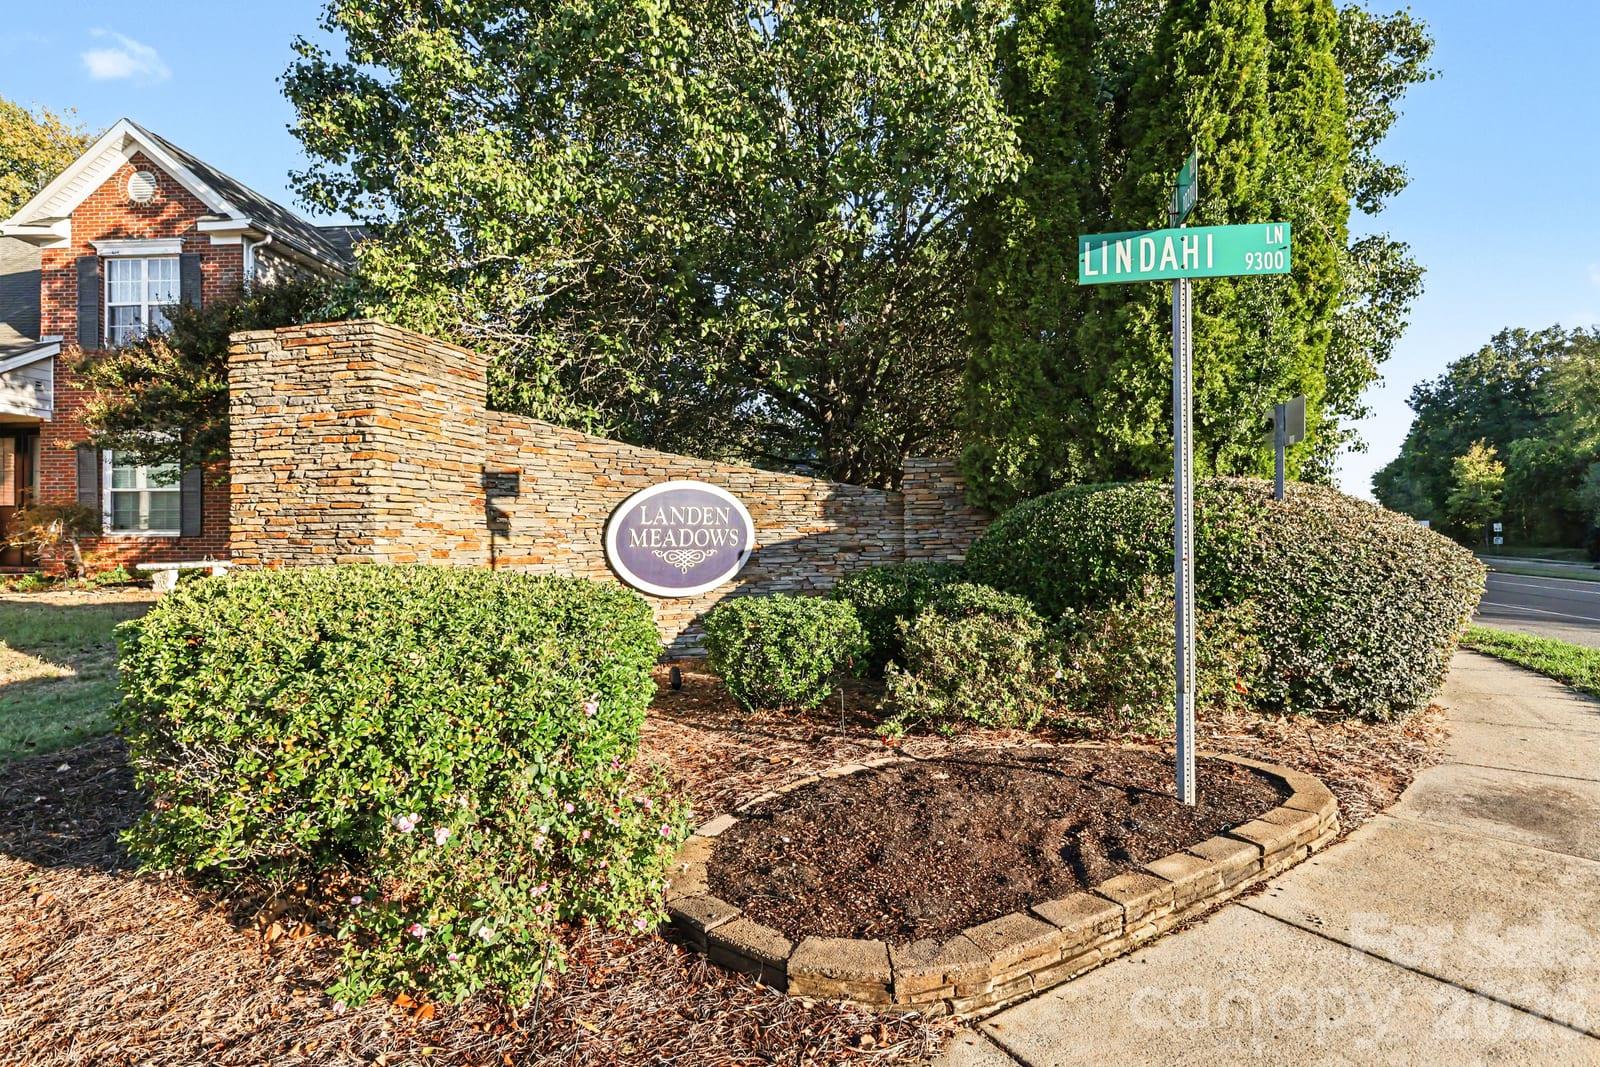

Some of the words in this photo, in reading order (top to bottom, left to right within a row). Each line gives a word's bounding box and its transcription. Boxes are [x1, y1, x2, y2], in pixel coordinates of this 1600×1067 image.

[1265, 225, 1284, 245] LN
[1084, 233, 1213, 276] LINDAHI
[1245, 251, 1284, 271] 9300
[640, 505, 731, 526] LANDEN
[629, 528, 739, 548] MEADOWS
